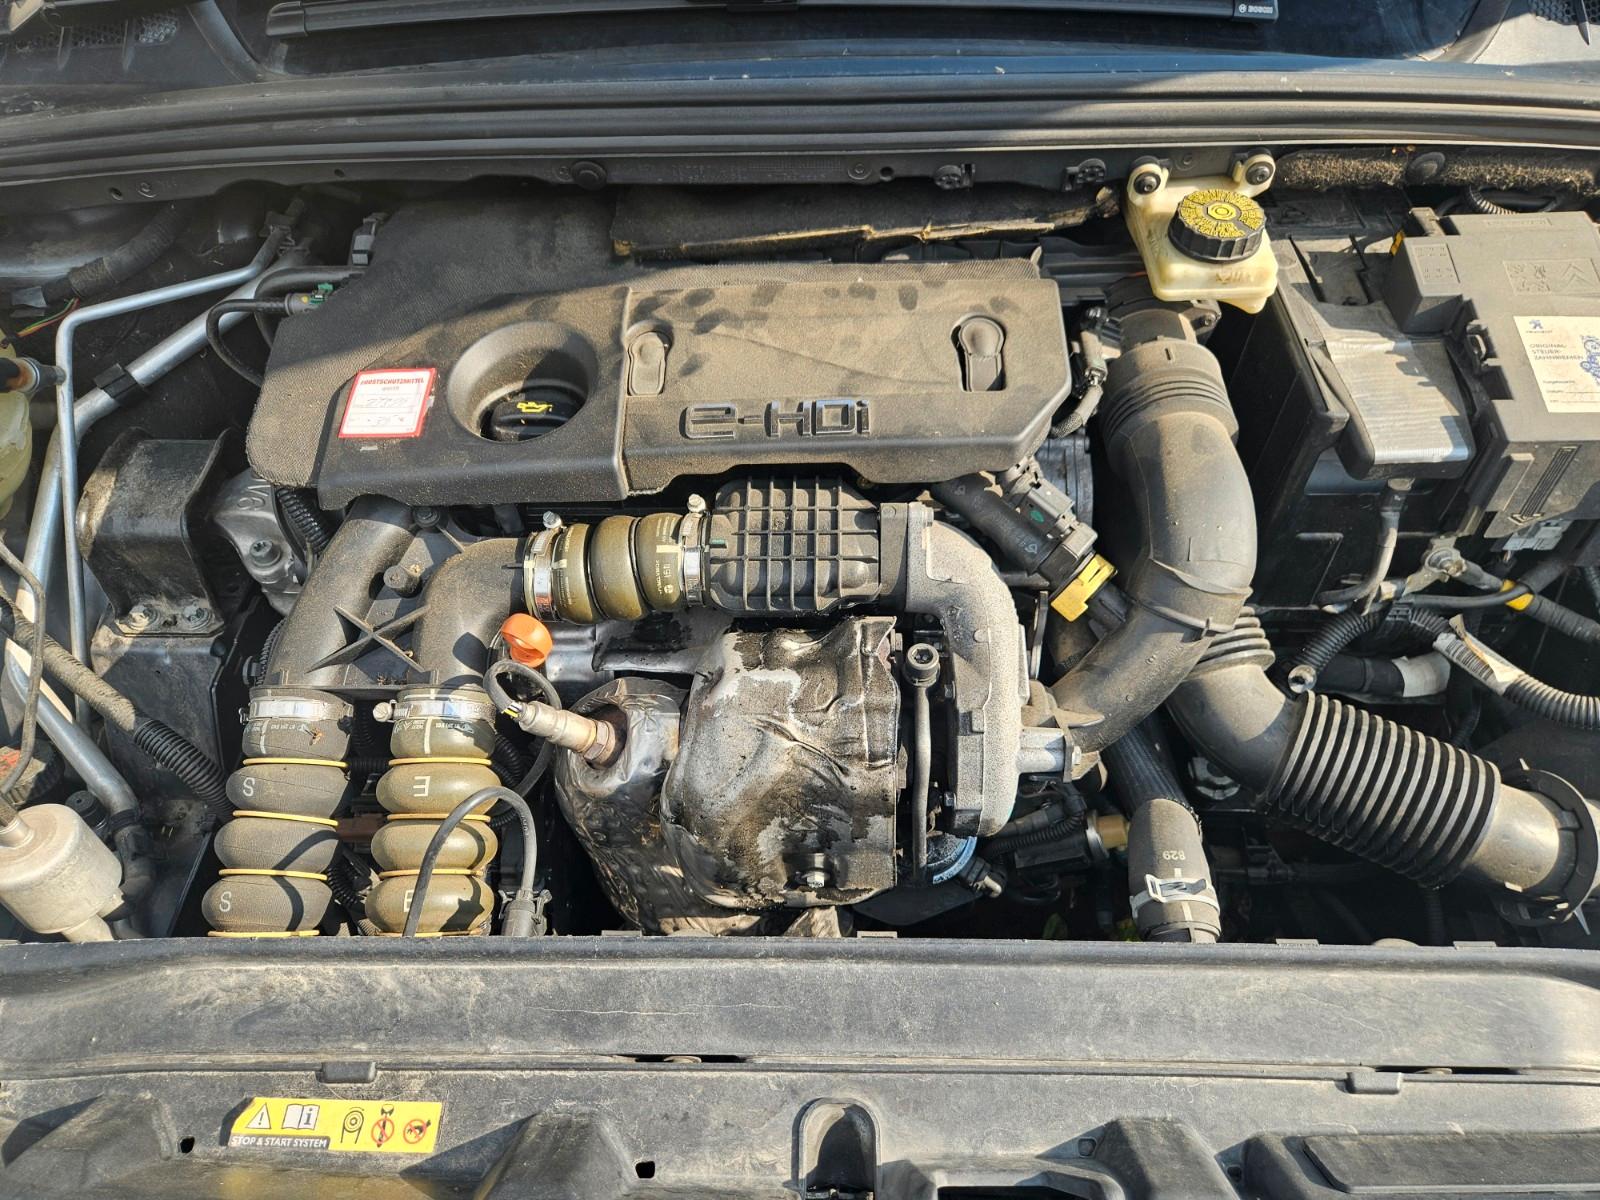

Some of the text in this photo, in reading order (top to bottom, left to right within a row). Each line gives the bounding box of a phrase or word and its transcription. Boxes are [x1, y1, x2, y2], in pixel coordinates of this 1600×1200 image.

[1248, 5, 1273, 13] BOSCH
[242, 776, 256, 797] S
[413, 775, 431, 798] E
[219, 891, 232, 912] S
[231, 1135, 328, 1148] STOP & START SYSTEM
